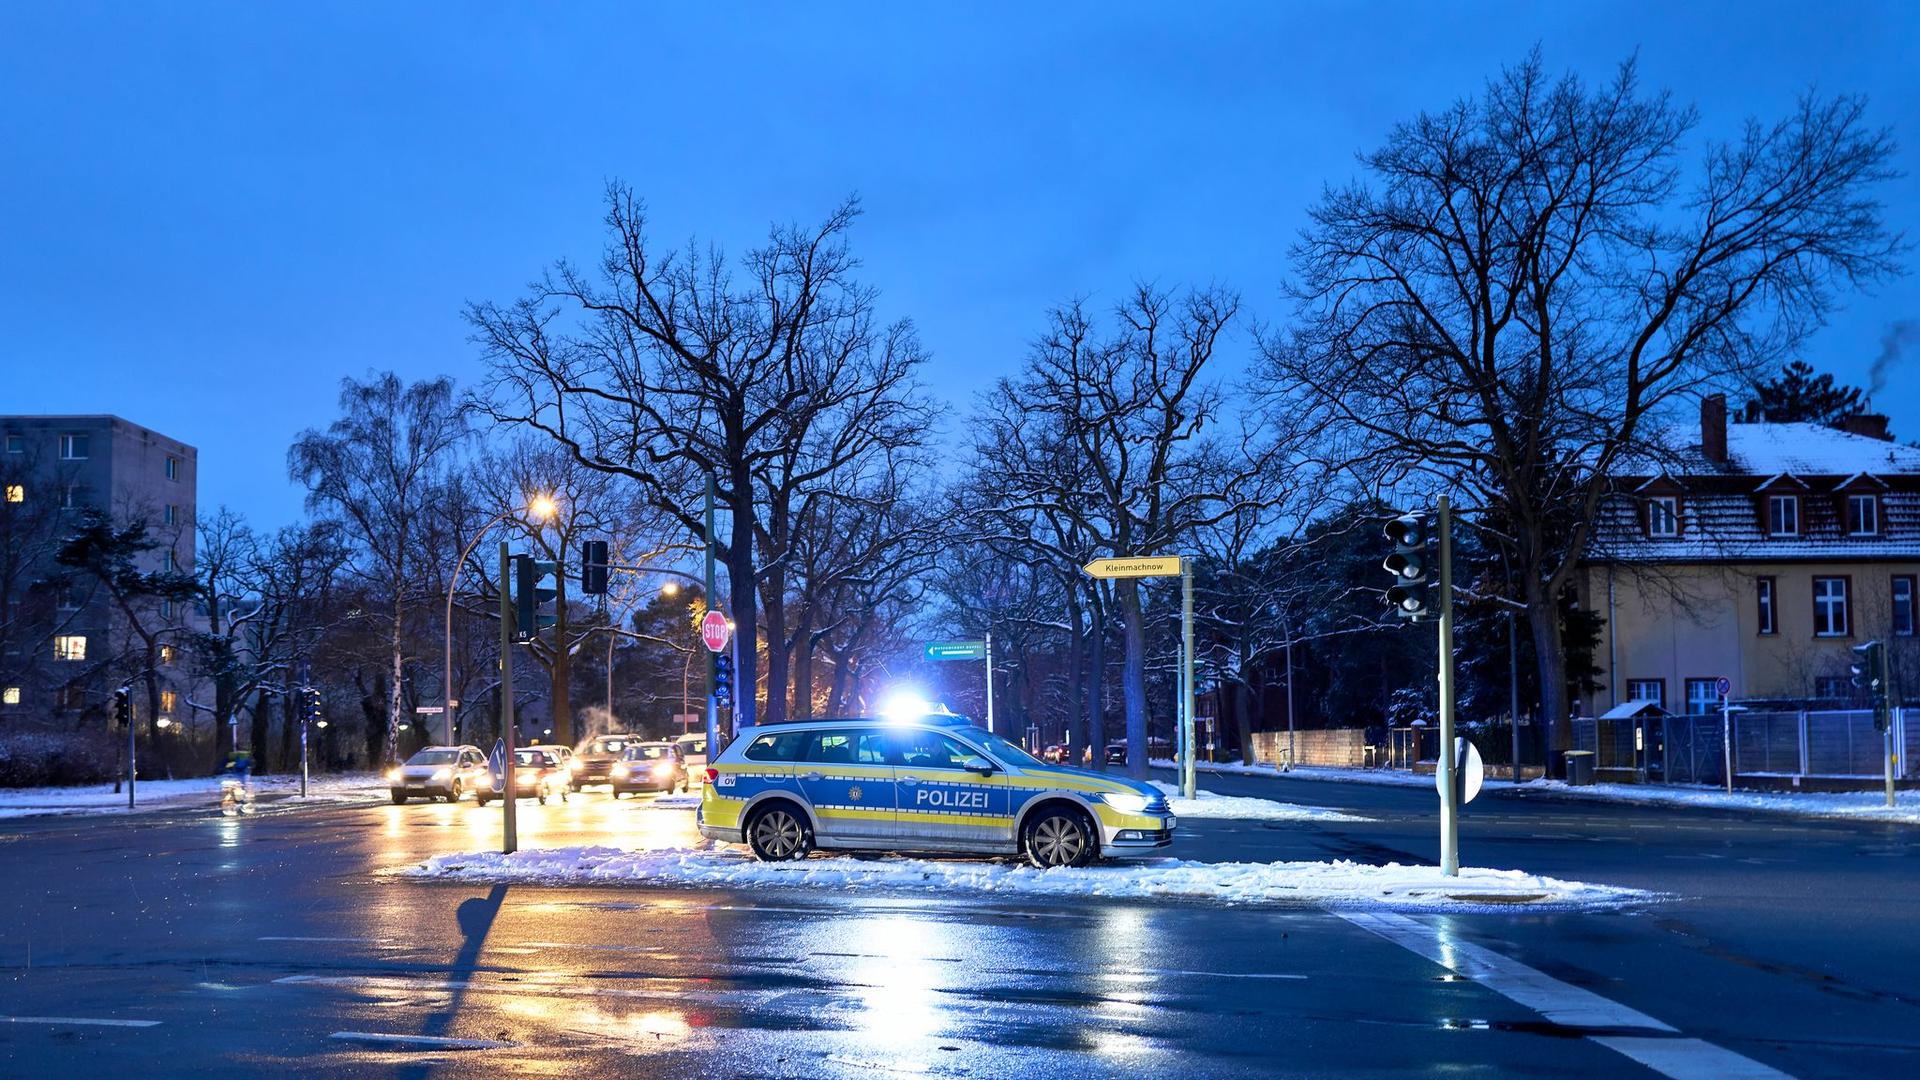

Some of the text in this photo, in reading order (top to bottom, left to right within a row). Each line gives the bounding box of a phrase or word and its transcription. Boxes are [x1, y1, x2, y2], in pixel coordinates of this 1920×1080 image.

[1105, 563, 1164, 572] Kleinmachnow
[705, 623, 726, 639] STOP
[916, 789, 989, 808] POLIZEI
